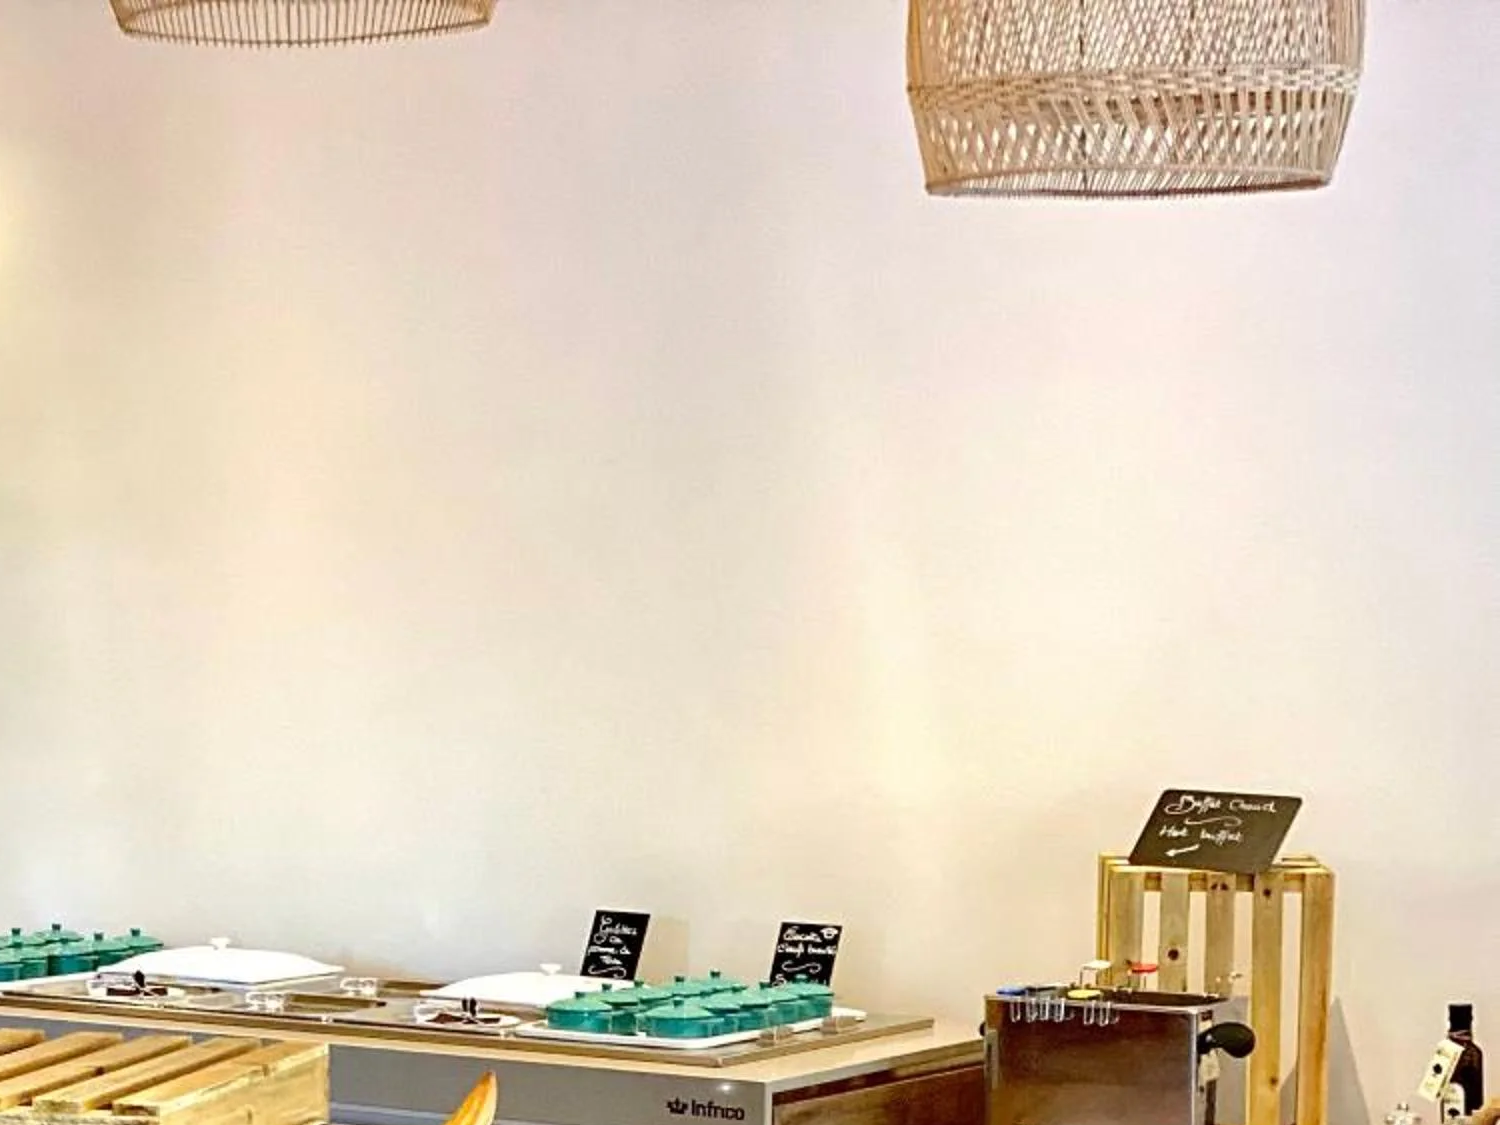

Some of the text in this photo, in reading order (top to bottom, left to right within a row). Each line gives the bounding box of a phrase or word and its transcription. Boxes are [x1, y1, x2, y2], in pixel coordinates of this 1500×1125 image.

[1158, 823, 1242, 846] Hot buffet
[691, 1099, 745, 1120] Infrico
